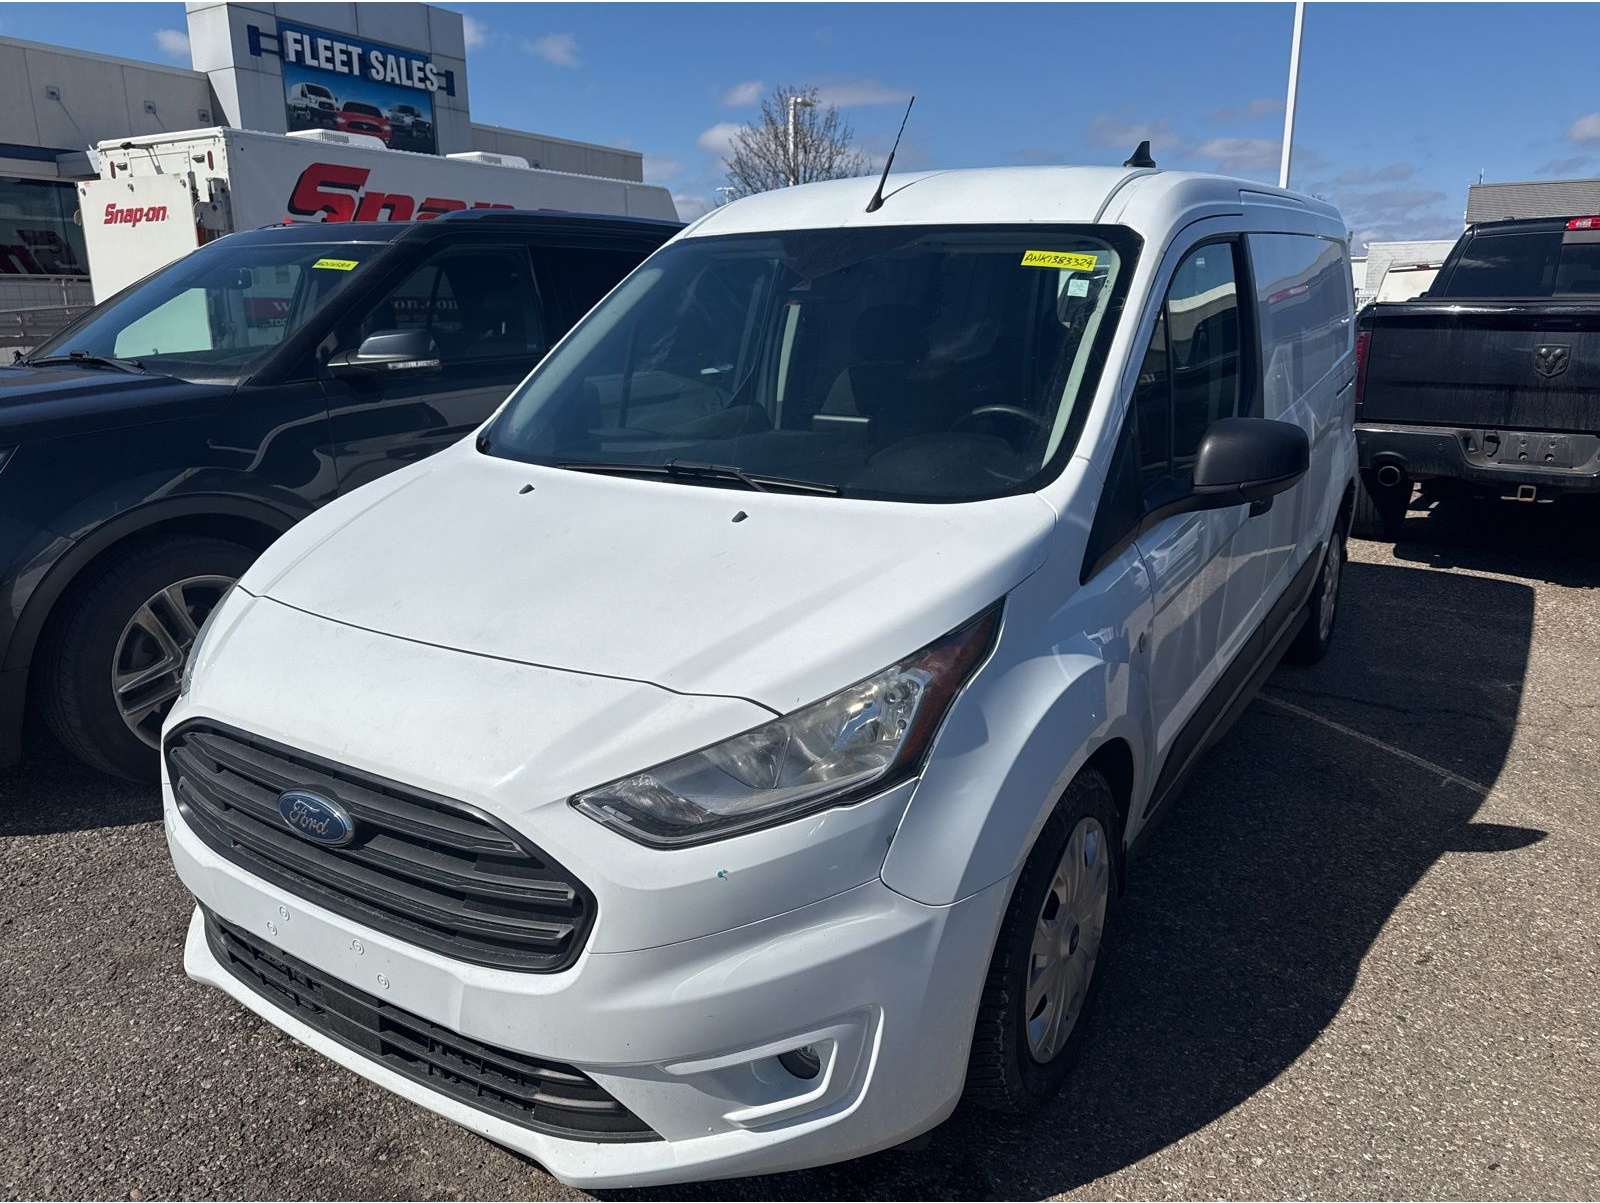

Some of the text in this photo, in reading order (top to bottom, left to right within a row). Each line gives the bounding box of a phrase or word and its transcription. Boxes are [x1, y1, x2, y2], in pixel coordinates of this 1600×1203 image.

[283, 30, 439, 92] FLEET SALES
[103, 203, 167, 228] Snap-on
[289, 800, 331, 835] Ford
